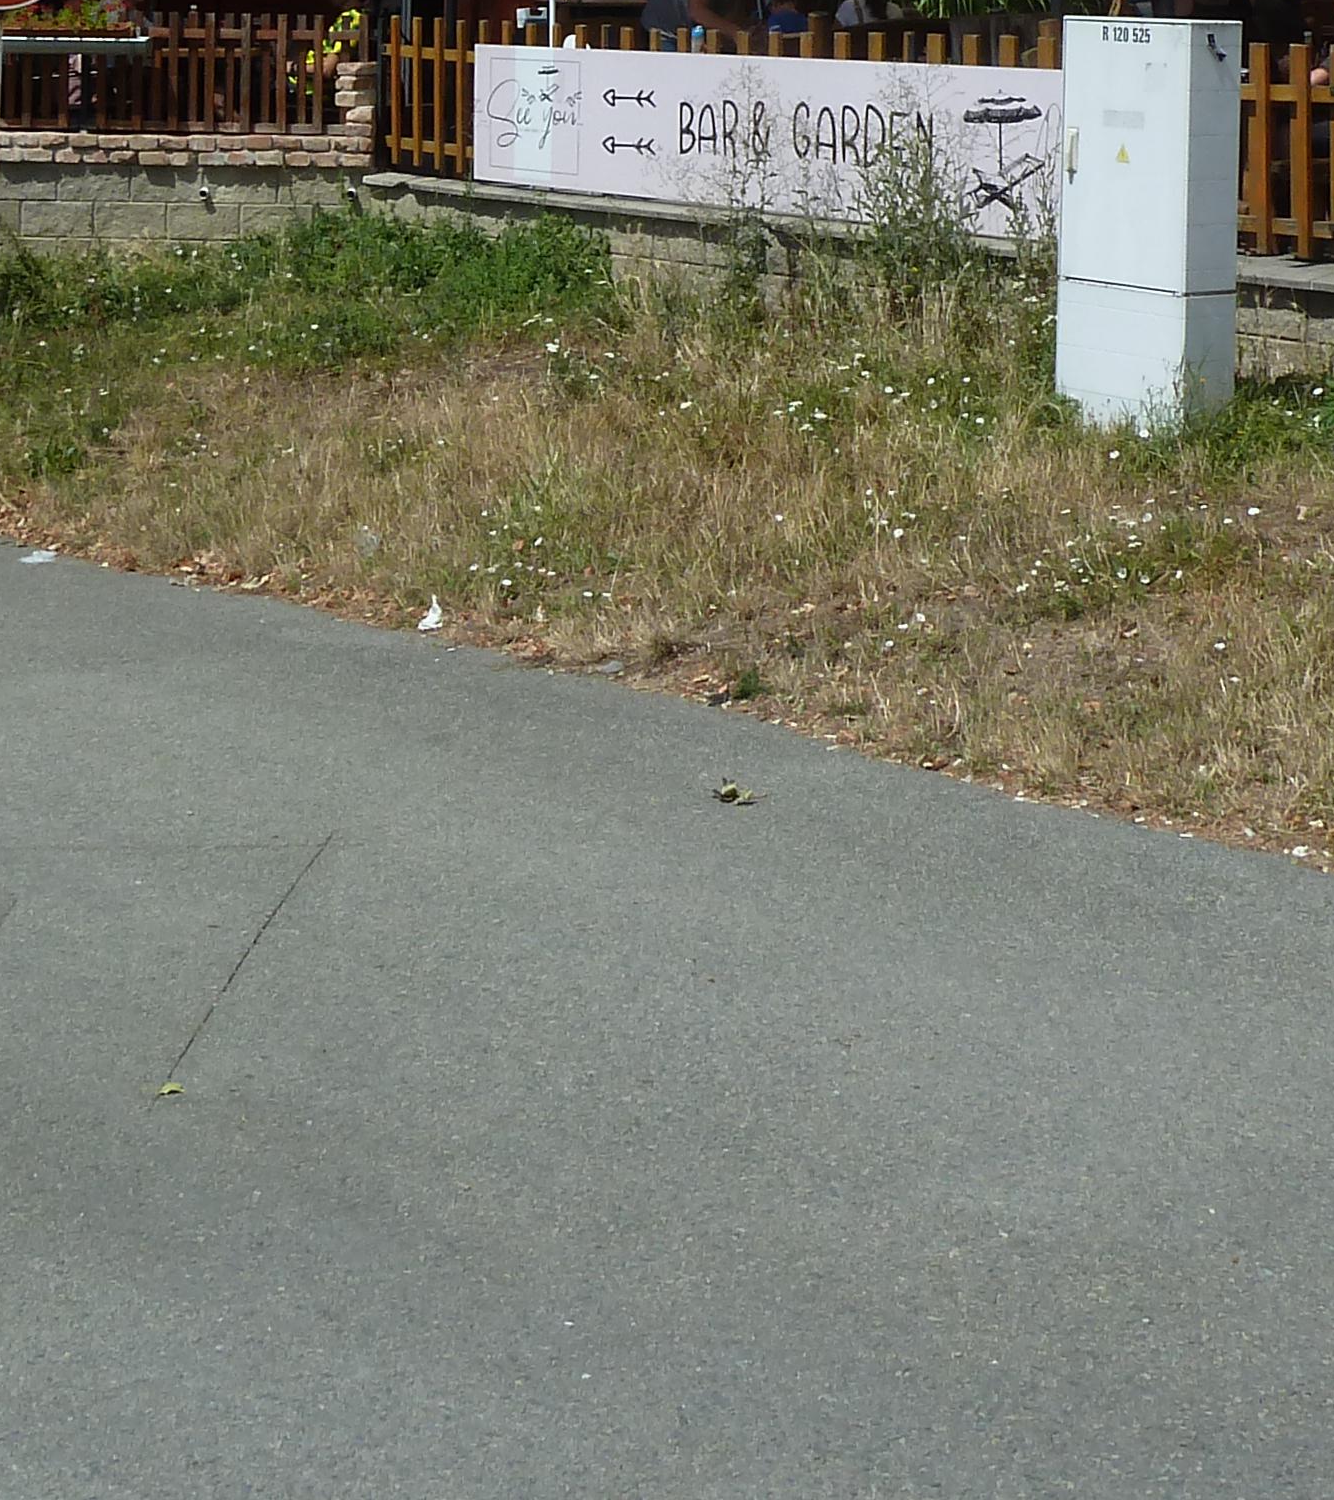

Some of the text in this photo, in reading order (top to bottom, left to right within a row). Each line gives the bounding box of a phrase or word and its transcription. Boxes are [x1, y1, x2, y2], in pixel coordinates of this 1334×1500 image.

[1102, 26, 1151, 44] R 120 525
[679, 99, 934, 172] BAR & GARDEN
